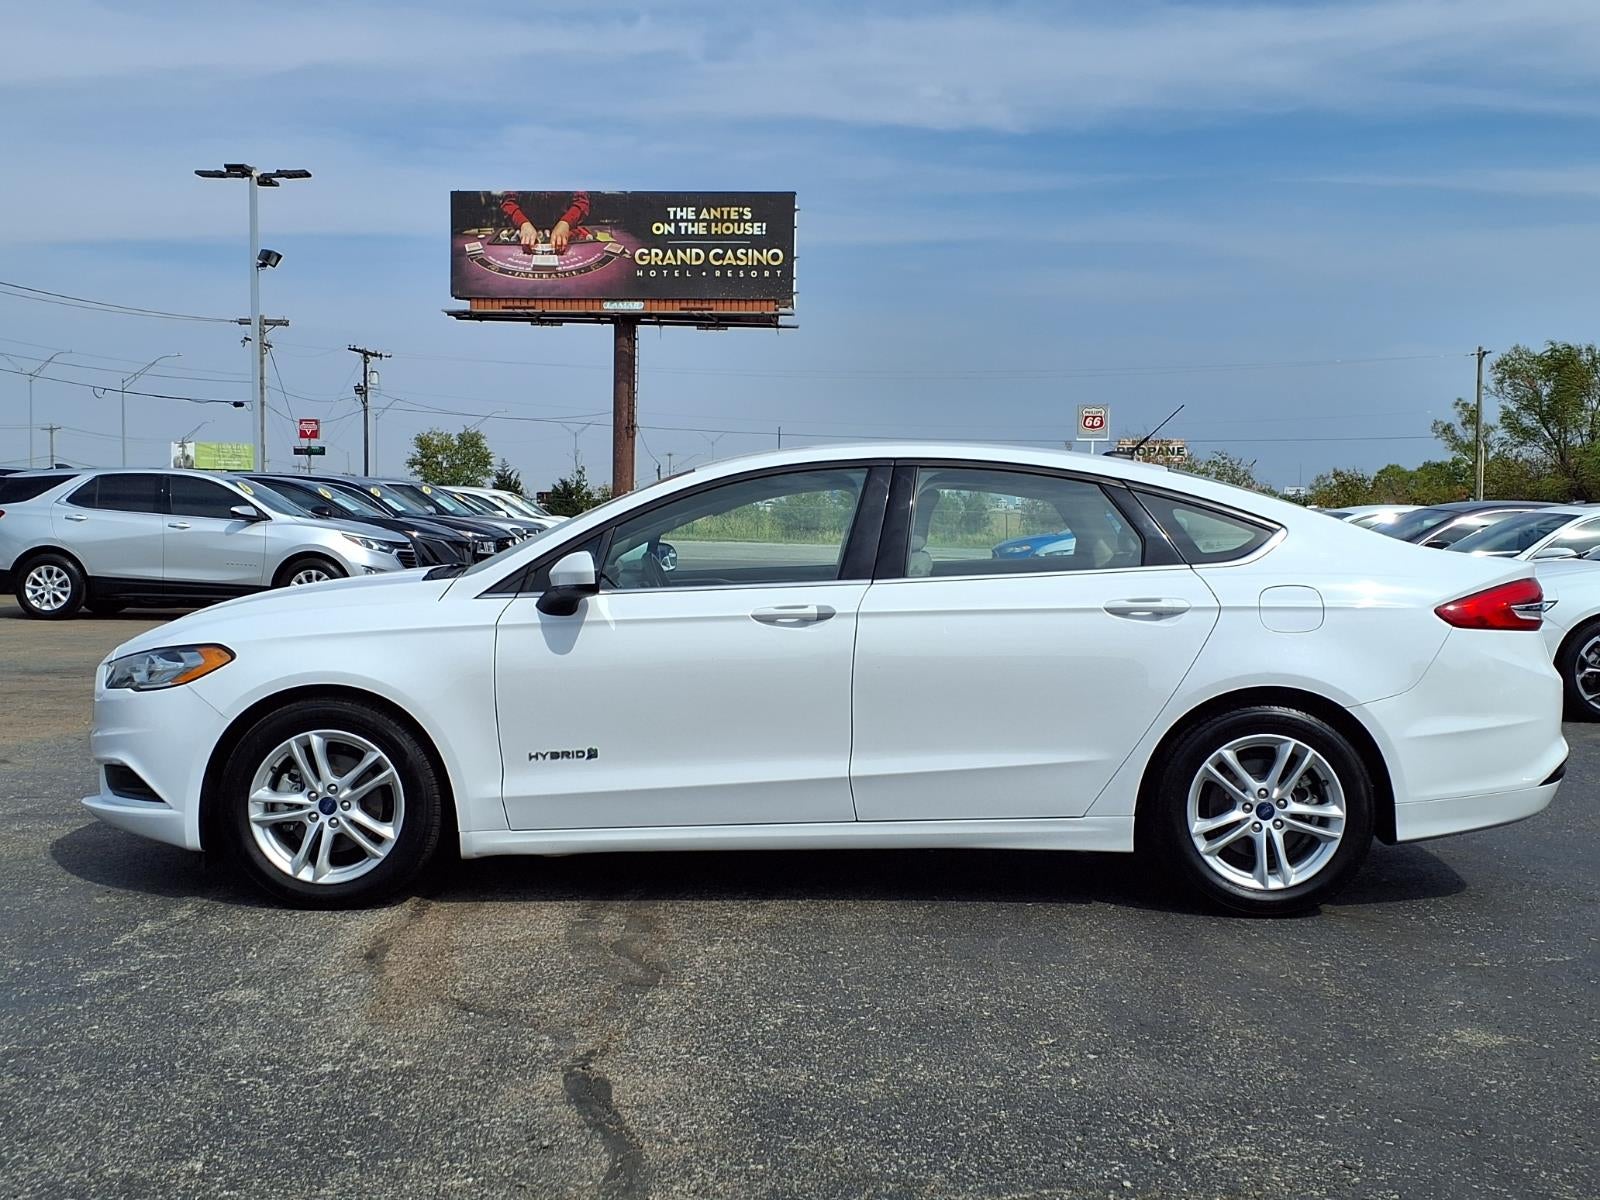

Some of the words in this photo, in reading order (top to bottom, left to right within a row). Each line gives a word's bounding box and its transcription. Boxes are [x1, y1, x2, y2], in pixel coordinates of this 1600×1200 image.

[667, 207, 696, 220] THE
[700, 207, 752, 220] ANTE'S
[652, 222, 675, 235] ON
[679, 222, 707, 235] THE
[711, 222, 767, 235] HOUSE!
[634, 248, 705, 266] GRAND
[709, 248, 784, 266] CASINO
[636, 270, 692, 278] HOTEL
[715, 270, 782, 278] RESORT
[1085, 416, 1102, 427] 66
[528, 750, 586, 761] HYBRID
